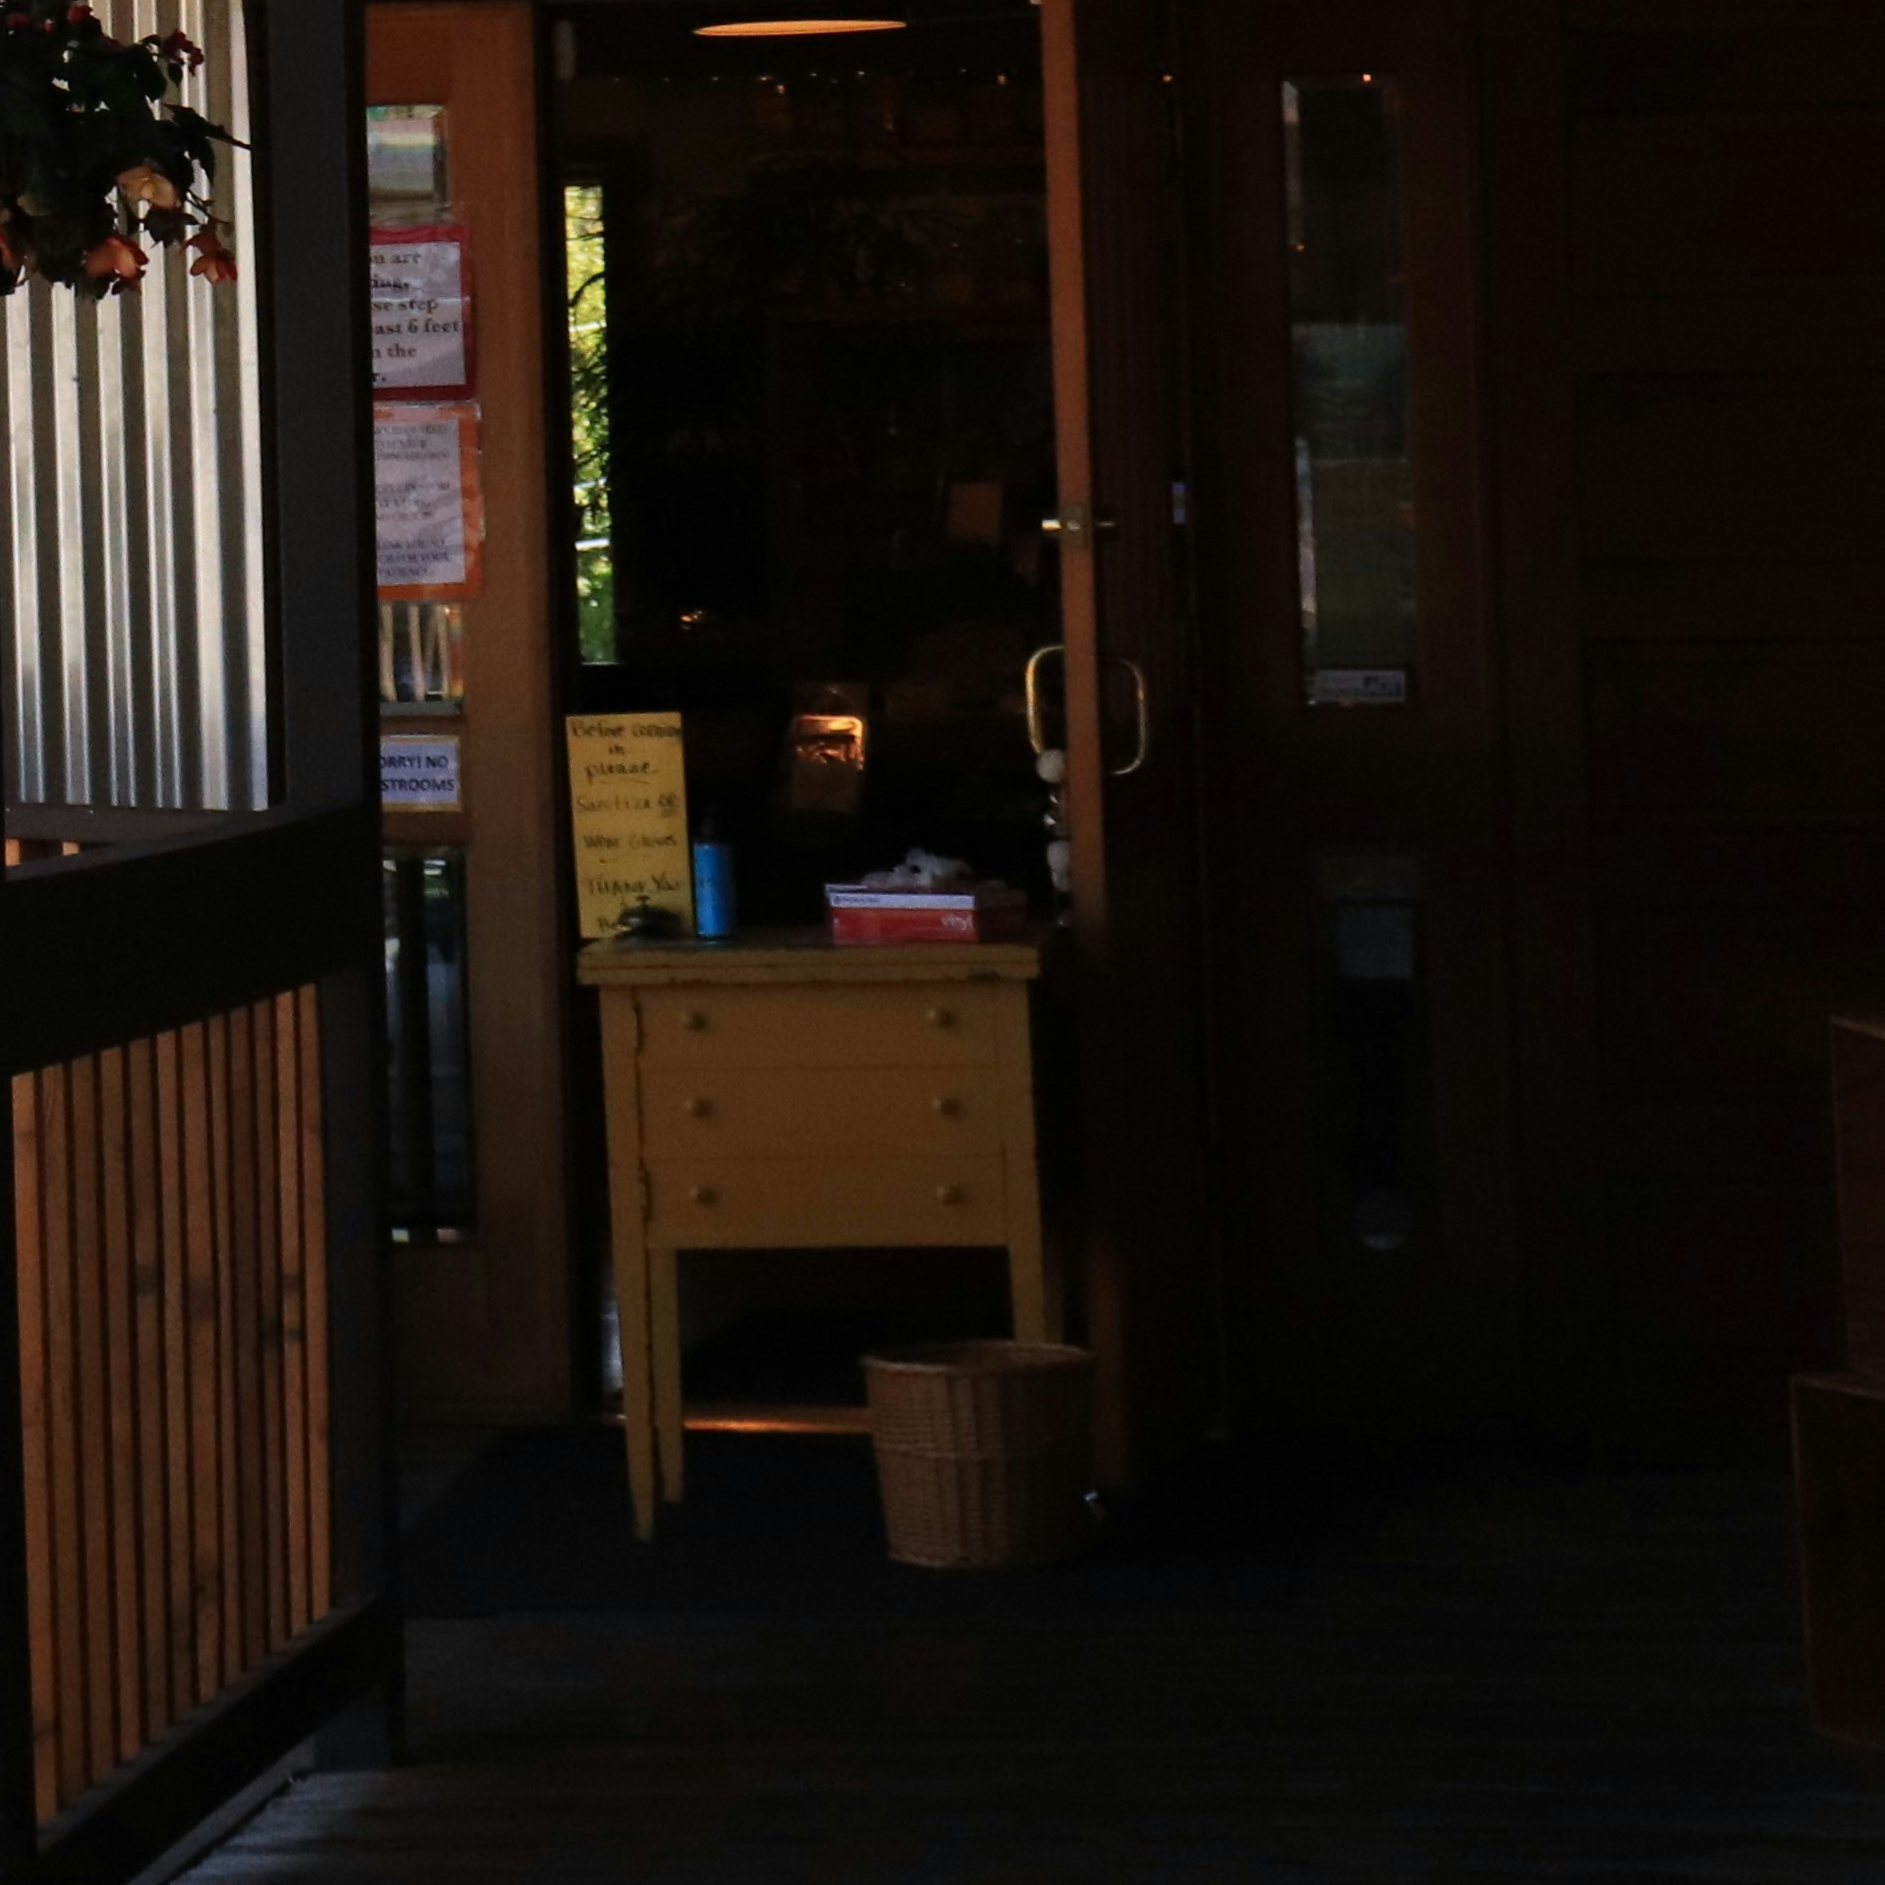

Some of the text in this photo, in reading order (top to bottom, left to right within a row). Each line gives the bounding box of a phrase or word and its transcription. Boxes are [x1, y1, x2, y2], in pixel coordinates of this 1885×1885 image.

[397, 299, 438, 314] step
[407, 317, 418, 333] 6
[424, 318, 459, 333] feet
[387, 342, 417, 358] the
[570, 718, 626, 738] Before
[426, 754, 449, 769] NO
